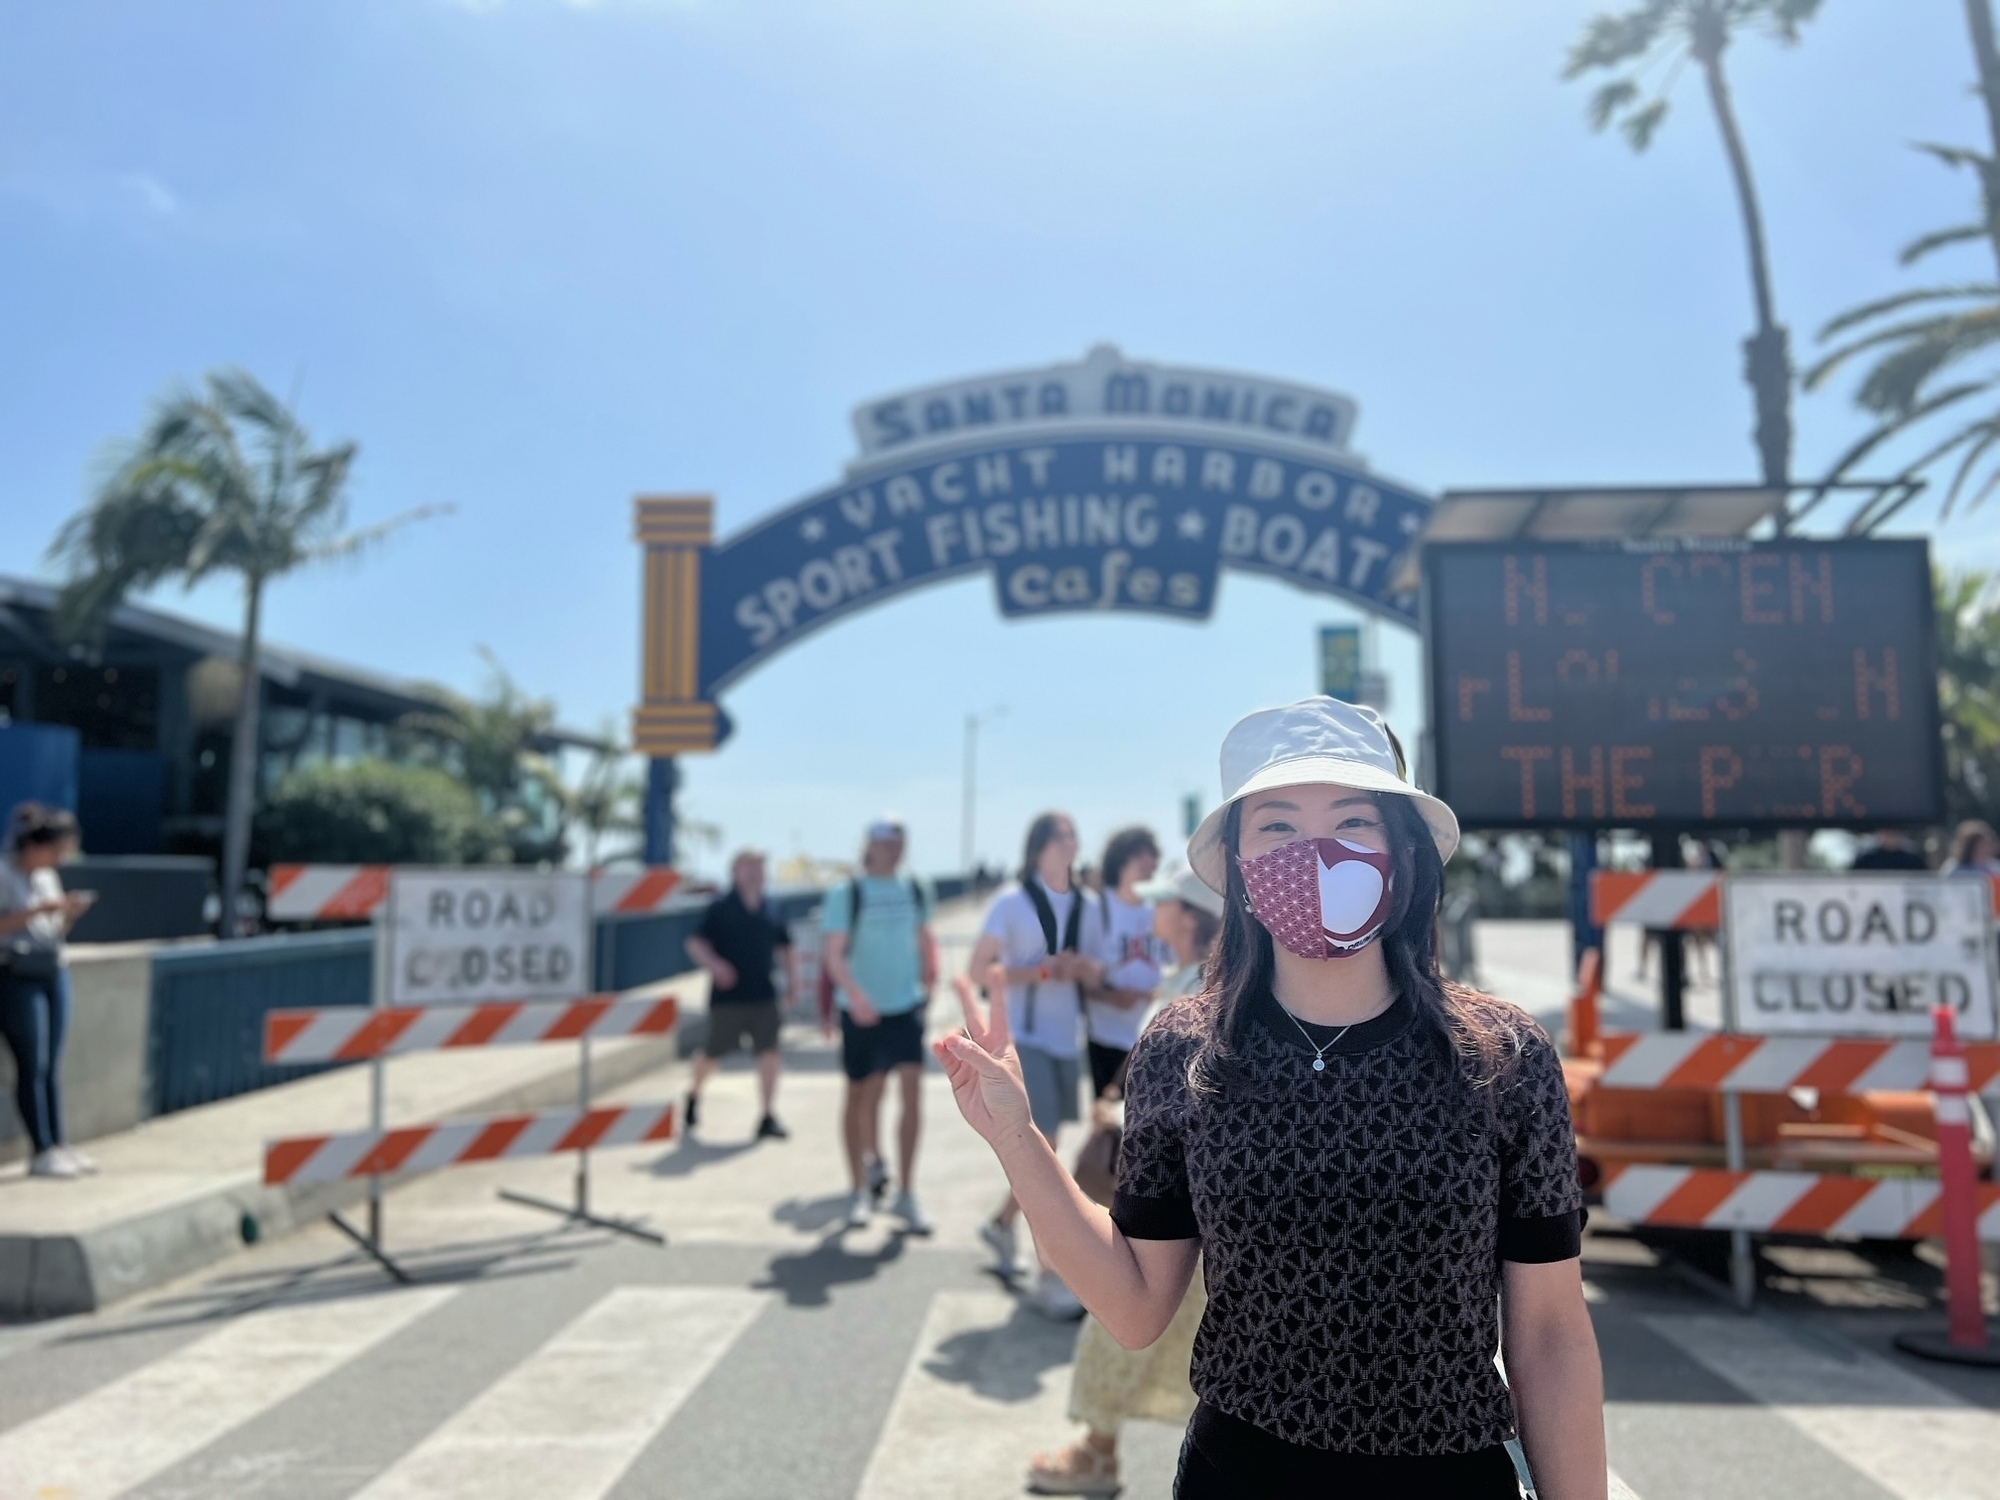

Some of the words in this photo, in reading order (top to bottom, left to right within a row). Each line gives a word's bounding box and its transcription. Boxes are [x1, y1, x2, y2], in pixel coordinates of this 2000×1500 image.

[871, 381, 1069, 446] SANTA
[1103, 371, 1339, 439] MONICA
[838, 449, 1056, 529] YACHT
[1103, 445, 1381, 528] HARBOR
[734, 527, 904, 646] SPORT
[925, 493, 1159, 566] FISHING
[1223, 506, 1412, 608] BOAT
[1501, 745, 1656, 820] THE
[427, 887, 556, 930] ROAD
[1774, 899, 1938, 945] ROAD
[1753, 970, 1972, 1014] CLOSED
